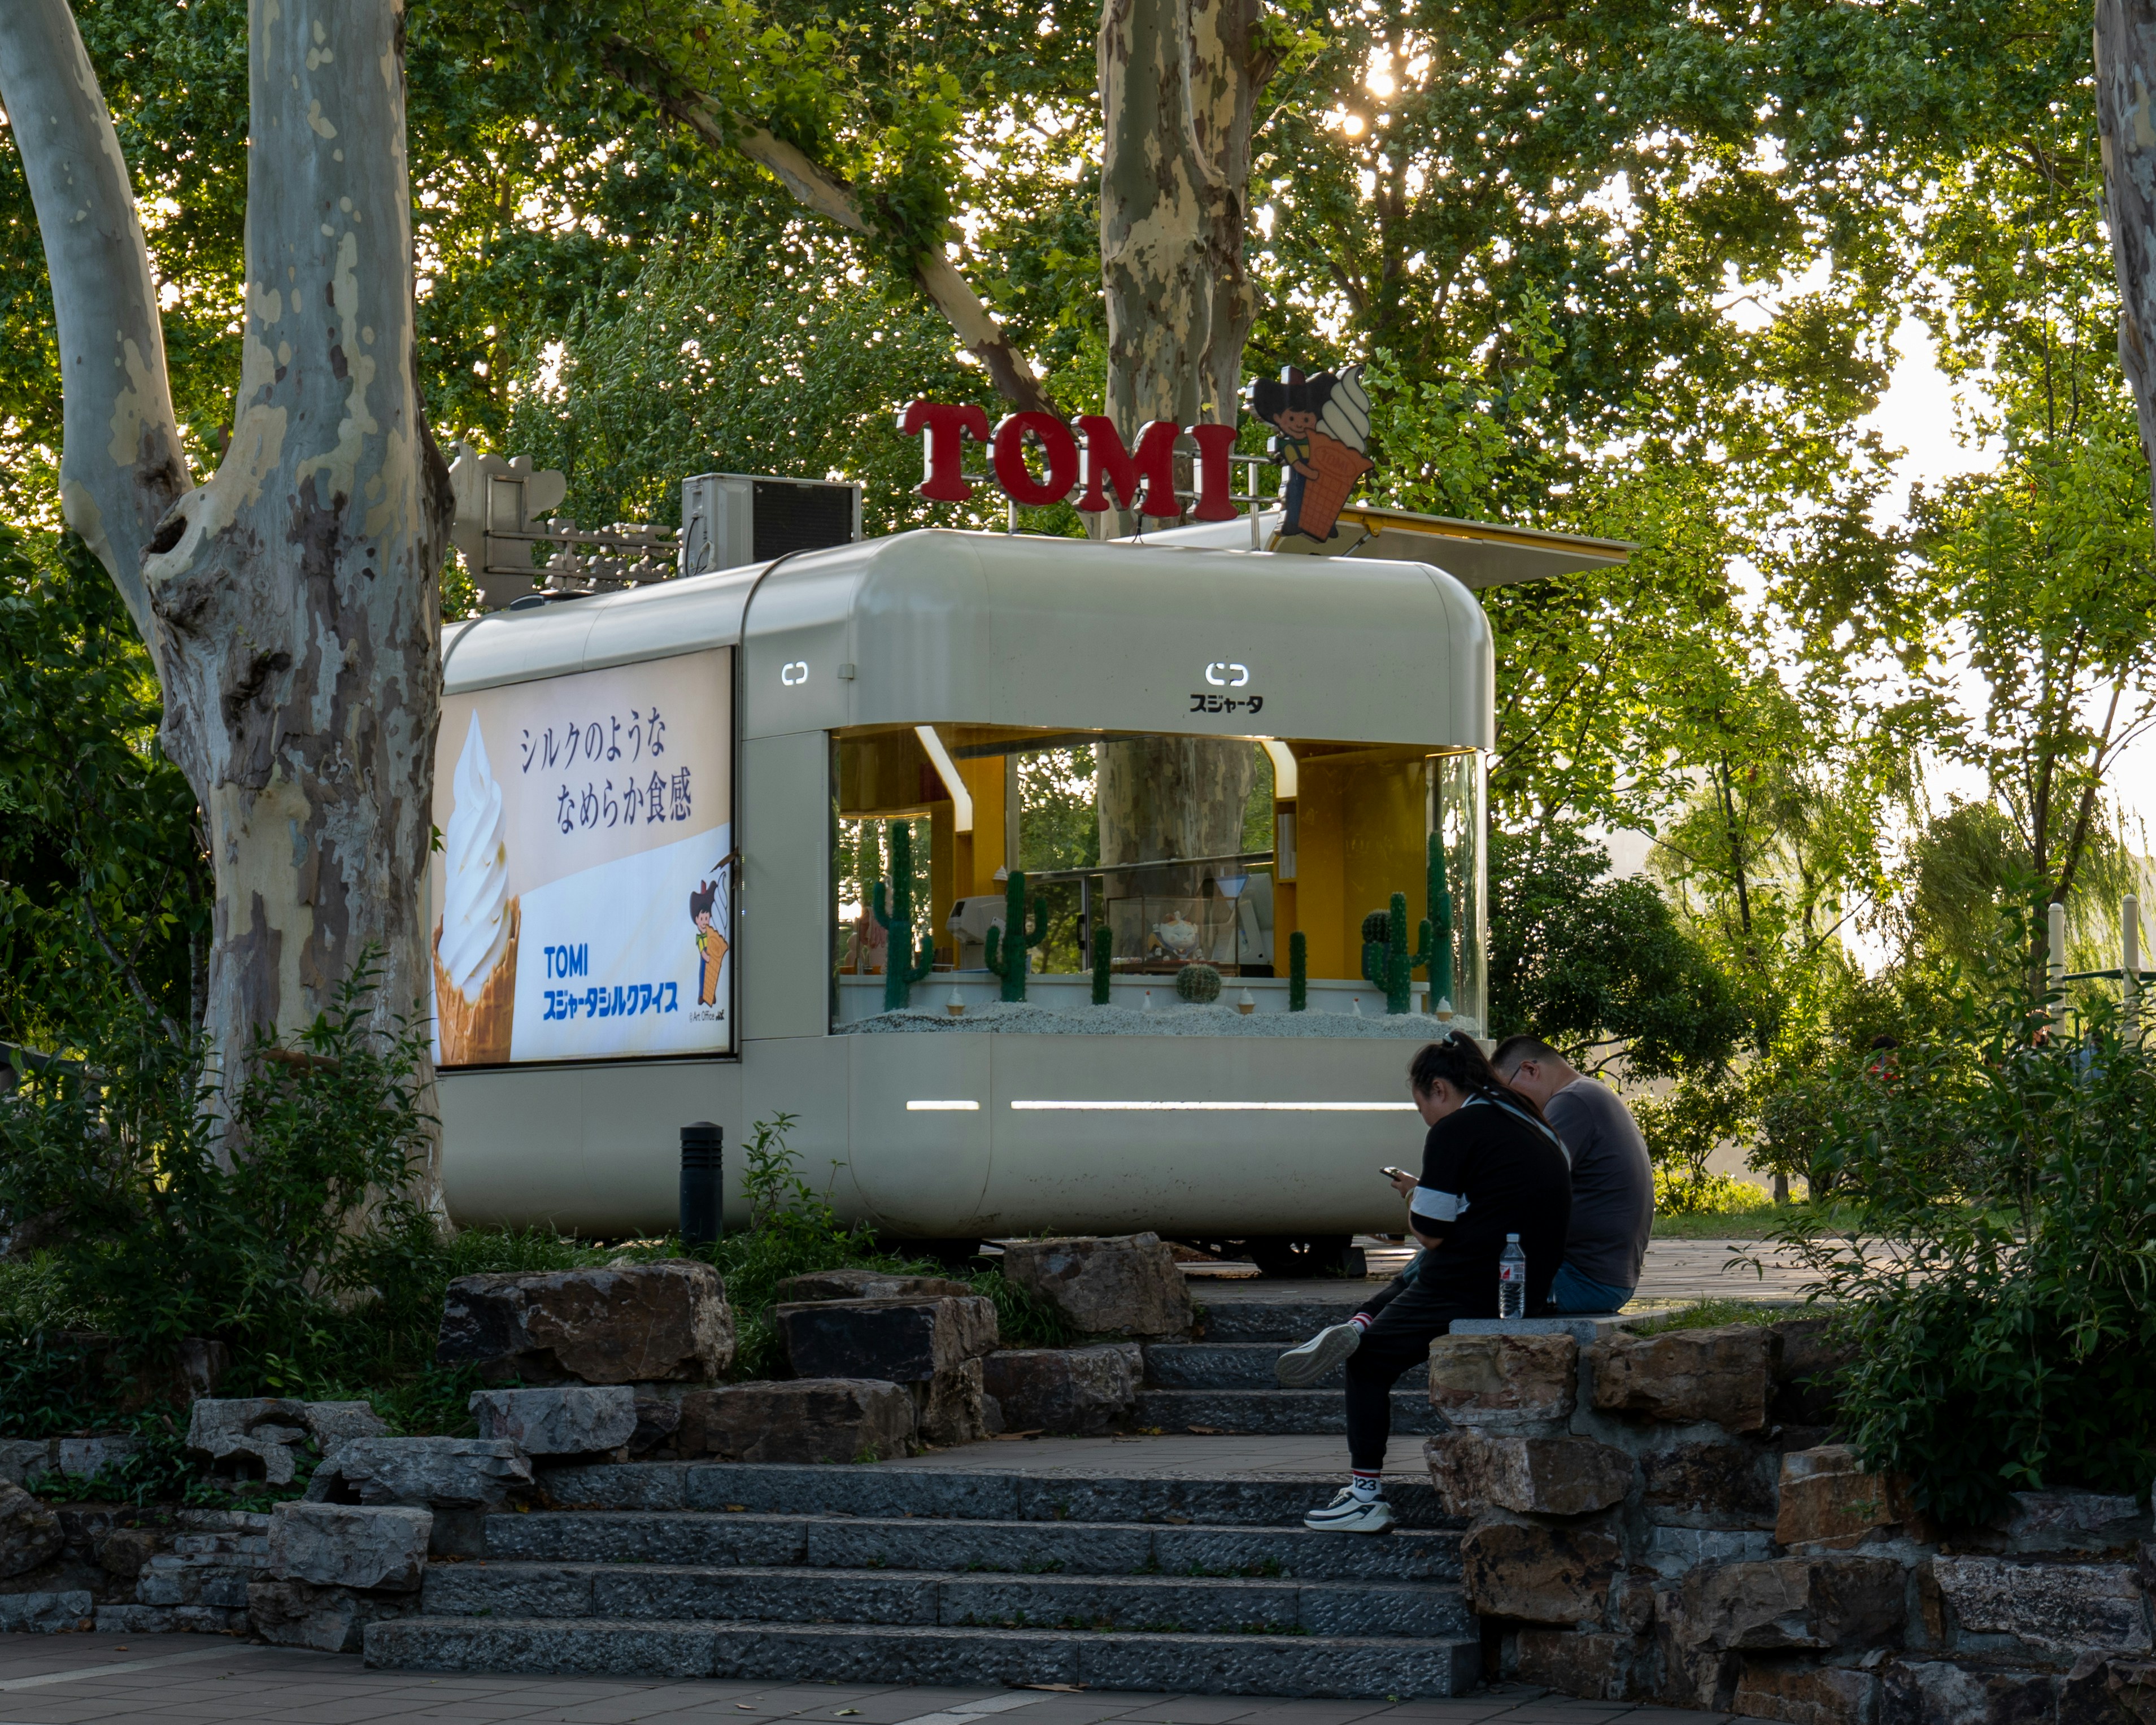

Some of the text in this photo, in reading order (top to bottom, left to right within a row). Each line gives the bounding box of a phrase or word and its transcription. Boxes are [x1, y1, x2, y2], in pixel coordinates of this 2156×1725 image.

[897, 400, 1238, 521] TOMI
[1190, 694, 1264, 714] スジャータ
[521, 707, 665, 774] シルクのような
[557, 766, 691, 834] なめらか食感
[543, 943, 588, 979] TOMI
[543, 982, 678, 1021] スジャータシルクアイス
[1354, 1477, 1376, 1491] 123
